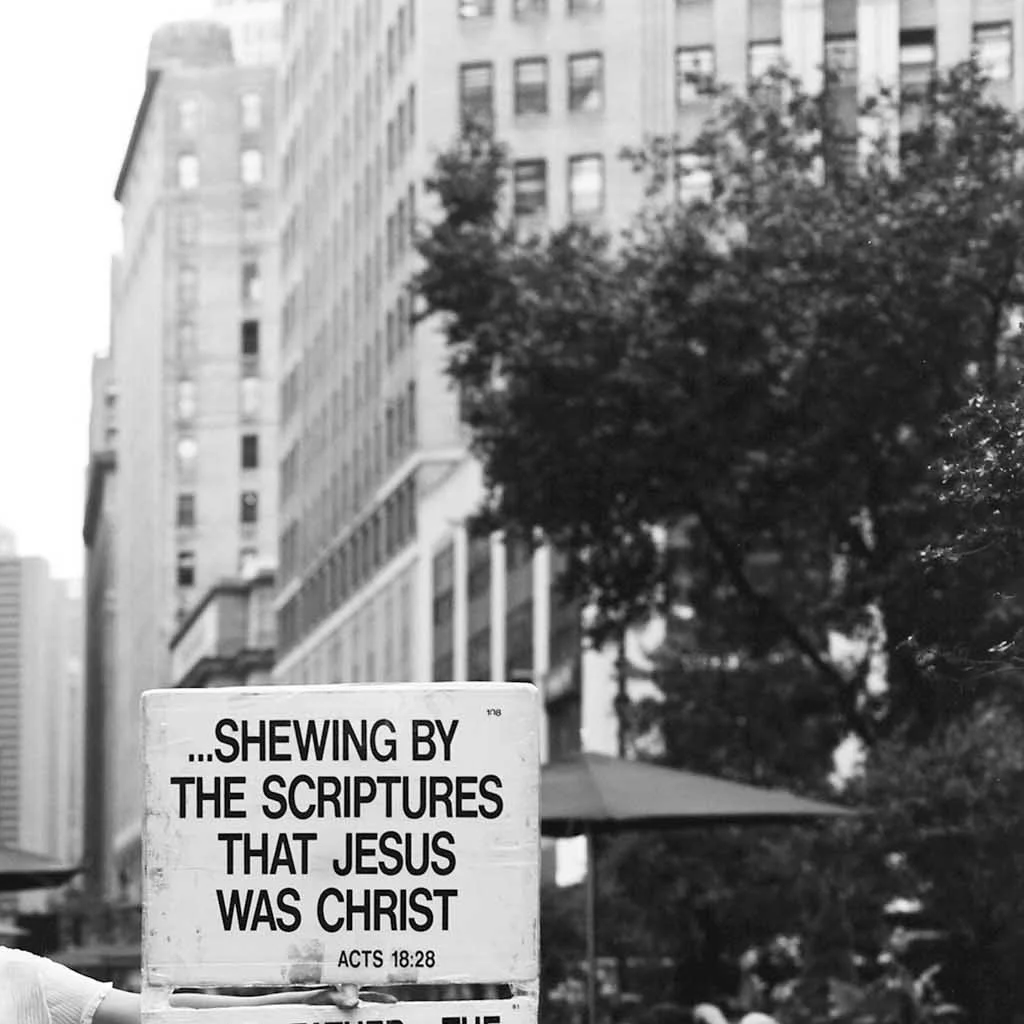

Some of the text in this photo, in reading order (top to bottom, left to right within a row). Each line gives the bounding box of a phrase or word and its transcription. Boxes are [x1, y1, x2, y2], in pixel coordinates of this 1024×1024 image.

[412, 720, 459, 761] BY
[171, 775, 503, 819] THE SCRIPTURES
[218, 831, 456, 876] THAT JESUS
[216, 888, 458, 933] WAS CHRIST
[338, 950, 435, 968] ACTS 18:28
